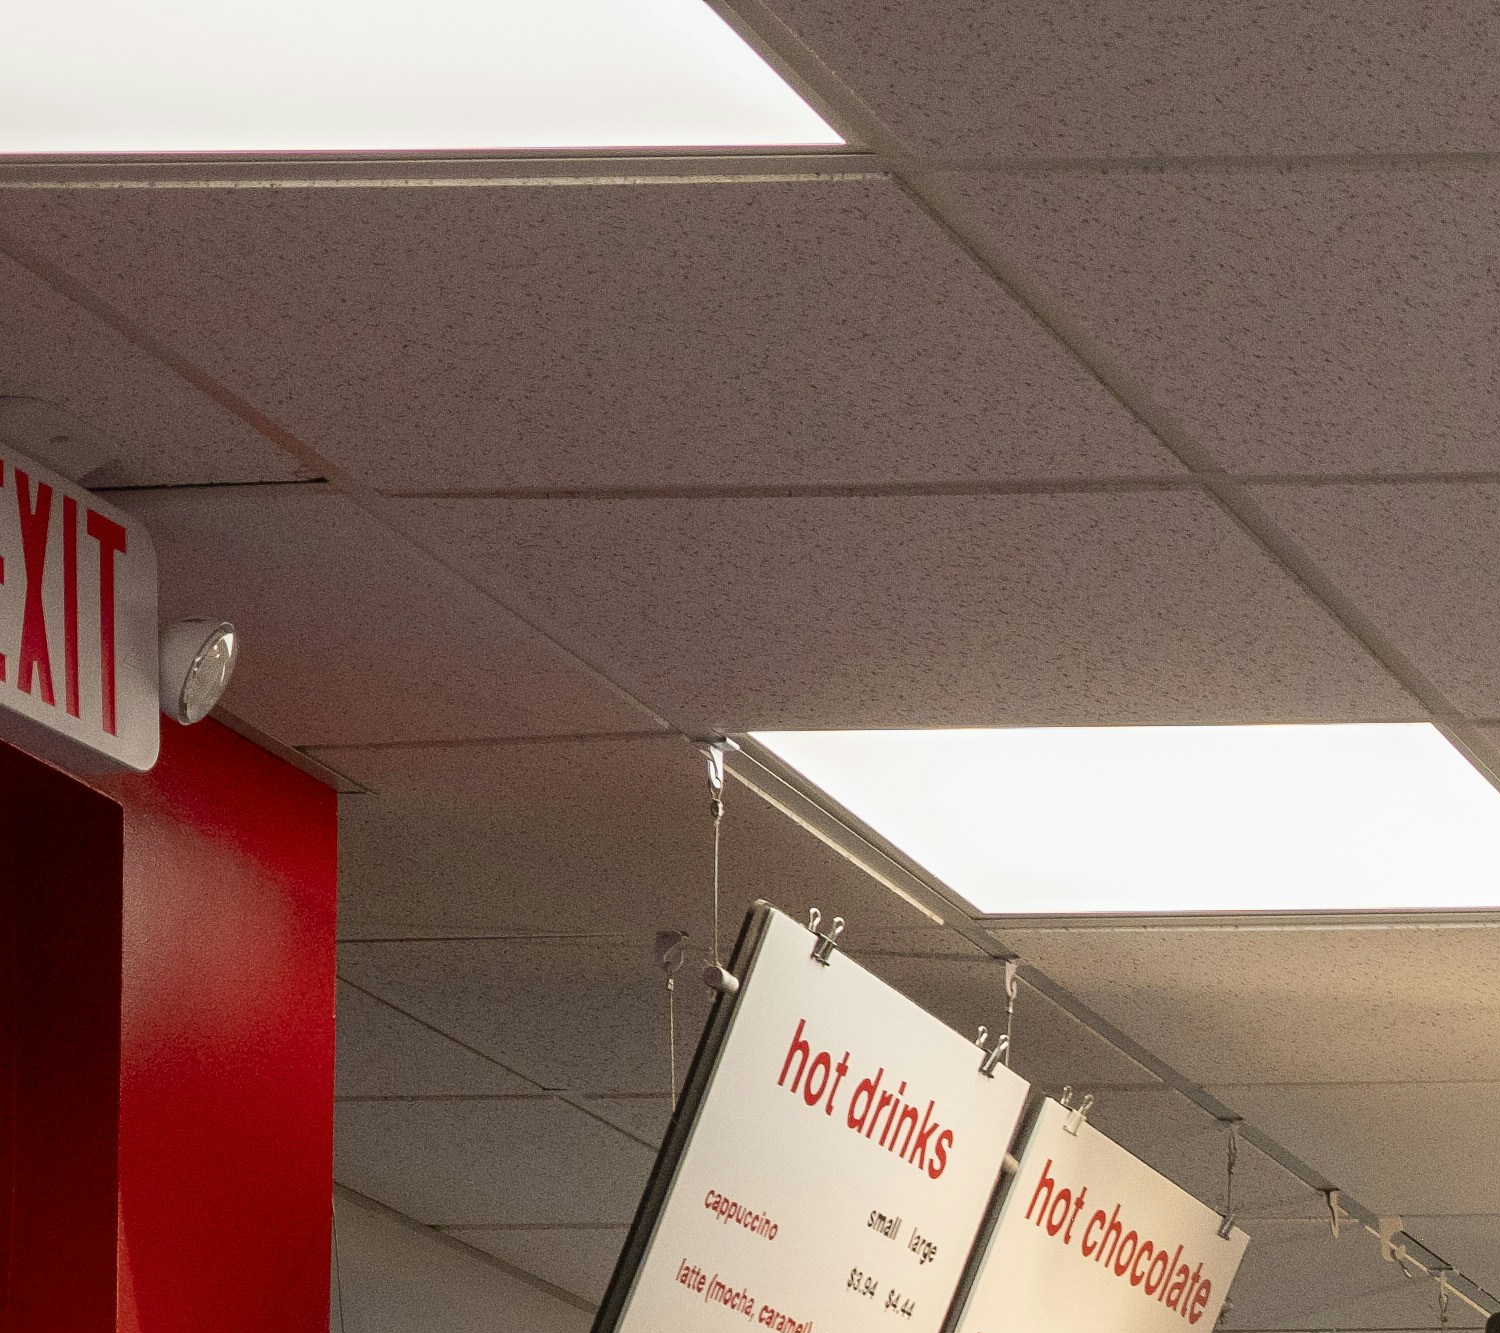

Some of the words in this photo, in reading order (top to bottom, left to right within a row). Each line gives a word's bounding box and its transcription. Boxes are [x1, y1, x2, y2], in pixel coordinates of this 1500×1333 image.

[778, 1019, 849, 1115] hot
[846, 1067, 953, 1179] drinks
[705, 1189, 778, 1241] cappuccino
[867, 1209, 902, 1240] small
[908, 1227, 937, 1264] large
[1025, 1158, 1087, 1245] hot
[1082, 1203, 1212, 1325] chocolate
